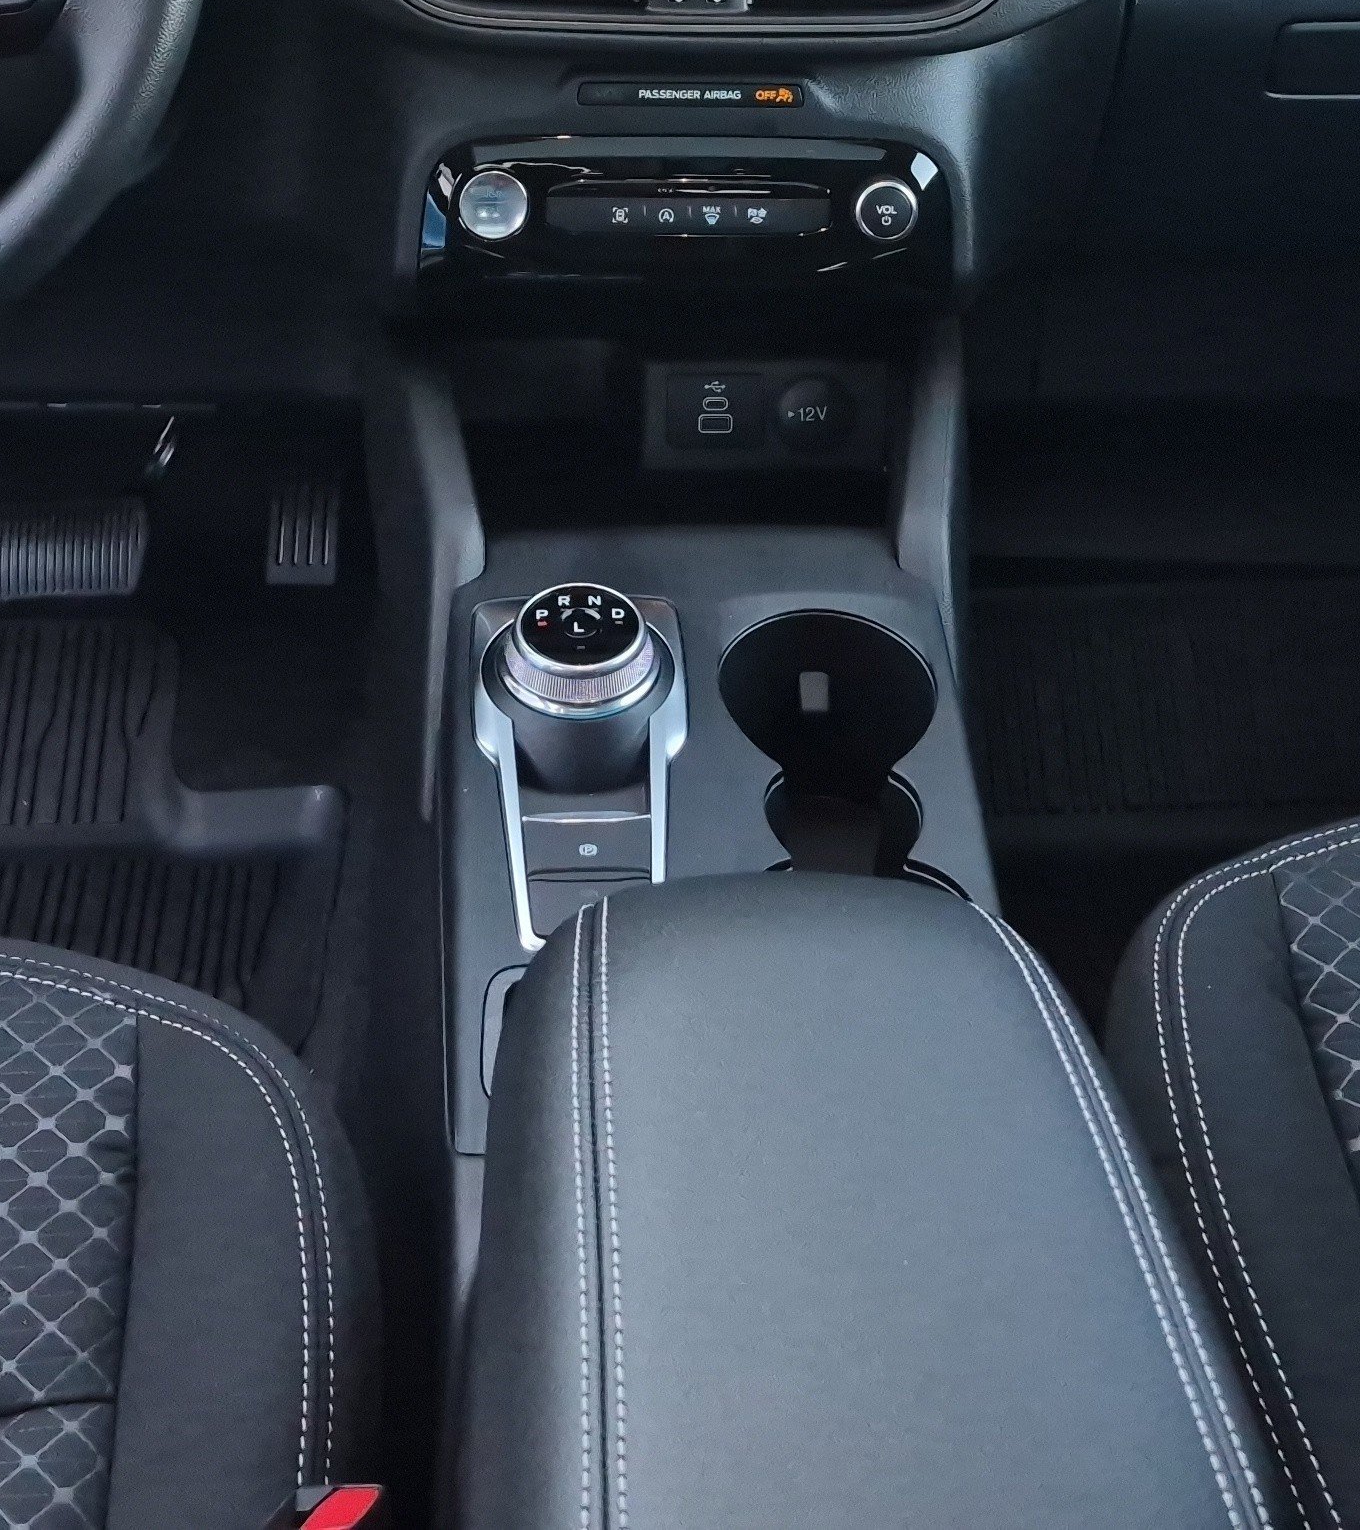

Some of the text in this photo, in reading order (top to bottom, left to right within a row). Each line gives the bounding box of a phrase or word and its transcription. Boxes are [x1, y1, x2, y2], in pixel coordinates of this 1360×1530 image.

[638, 89, 777, 101] PASSENGER AIRBAG OFF
[702, 205, 721, 214] MAX
[875, 205, 898, 215] VOL
[557, 595, 571, 607] R
[587, 595, 601, 607] N
[535, 609, 549, 620] P
[611, 608, 625, 620] D
[573, 621, 585, 633] L
